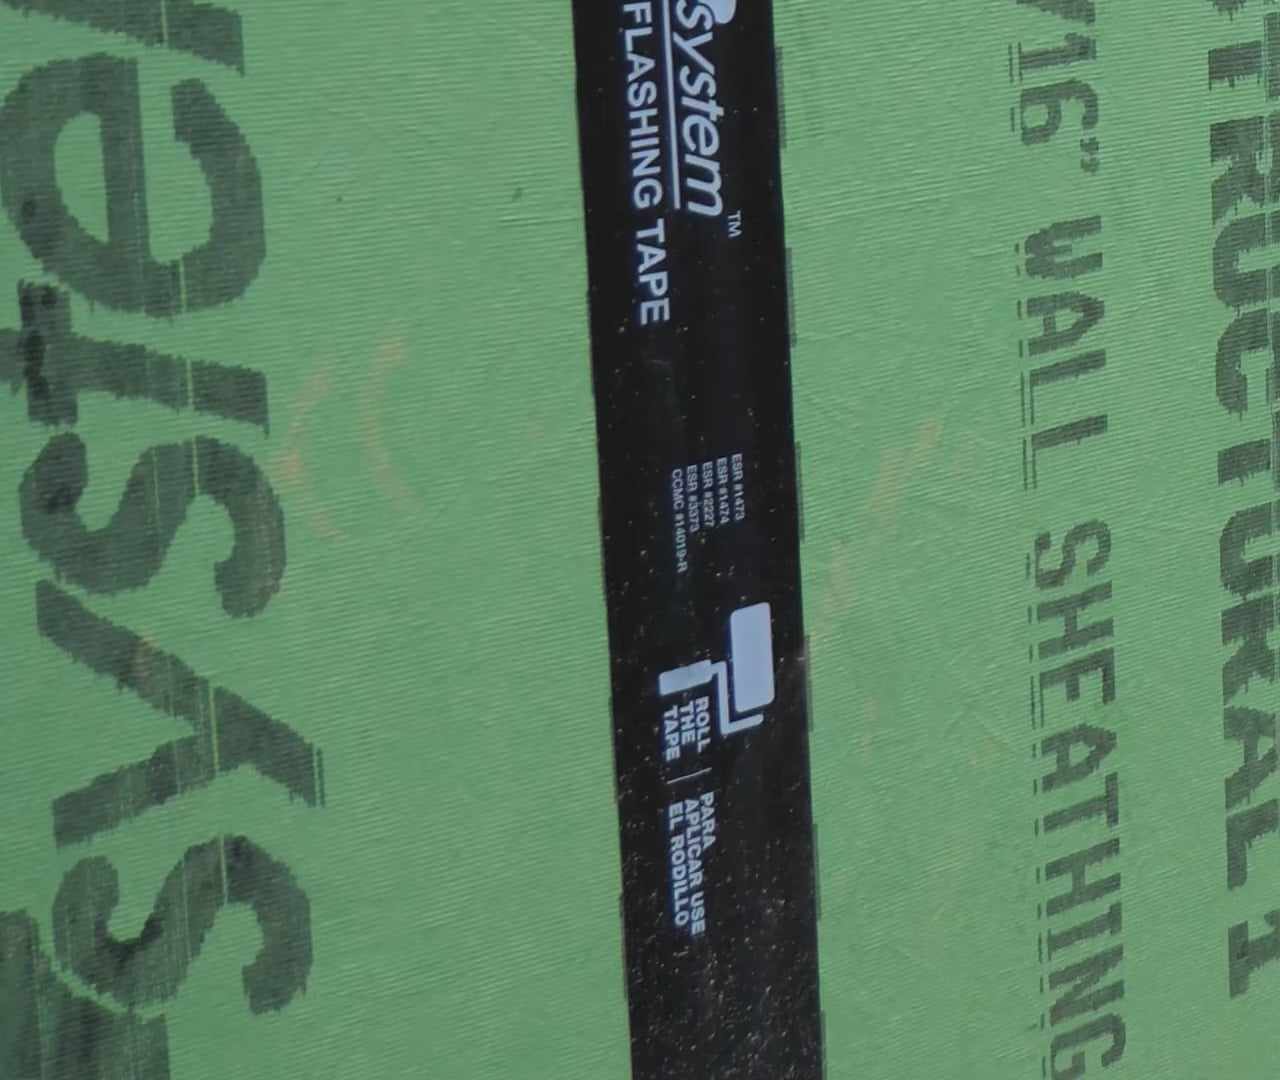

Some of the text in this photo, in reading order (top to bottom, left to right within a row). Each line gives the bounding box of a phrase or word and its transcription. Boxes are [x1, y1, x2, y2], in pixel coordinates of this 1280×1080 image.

[622, 0, 671, 327] FLASHING TAPE
[1020, 215, 1108, 487] WALL
[671, 468, 685, 511] CCMC
[686, 464, 700, 533] ESR #3373
[702, 460, 716, 528] ESR #2227
[716, 457, 731, 525] ESR #1474
[731, 452, 745, 521] ESR #1473
[663, 709, 682, 761] TAPE
[679, 699, 697, 746] THE
[695, 695, 713, 753] ROLL
[699, 791, 717, 850] PARA
[1030, 520, 1127, 1080] SHEATHING
[668, 802, 690, 927] EL RODILLO
[685, 798, 707, 937] APLICAR USE
